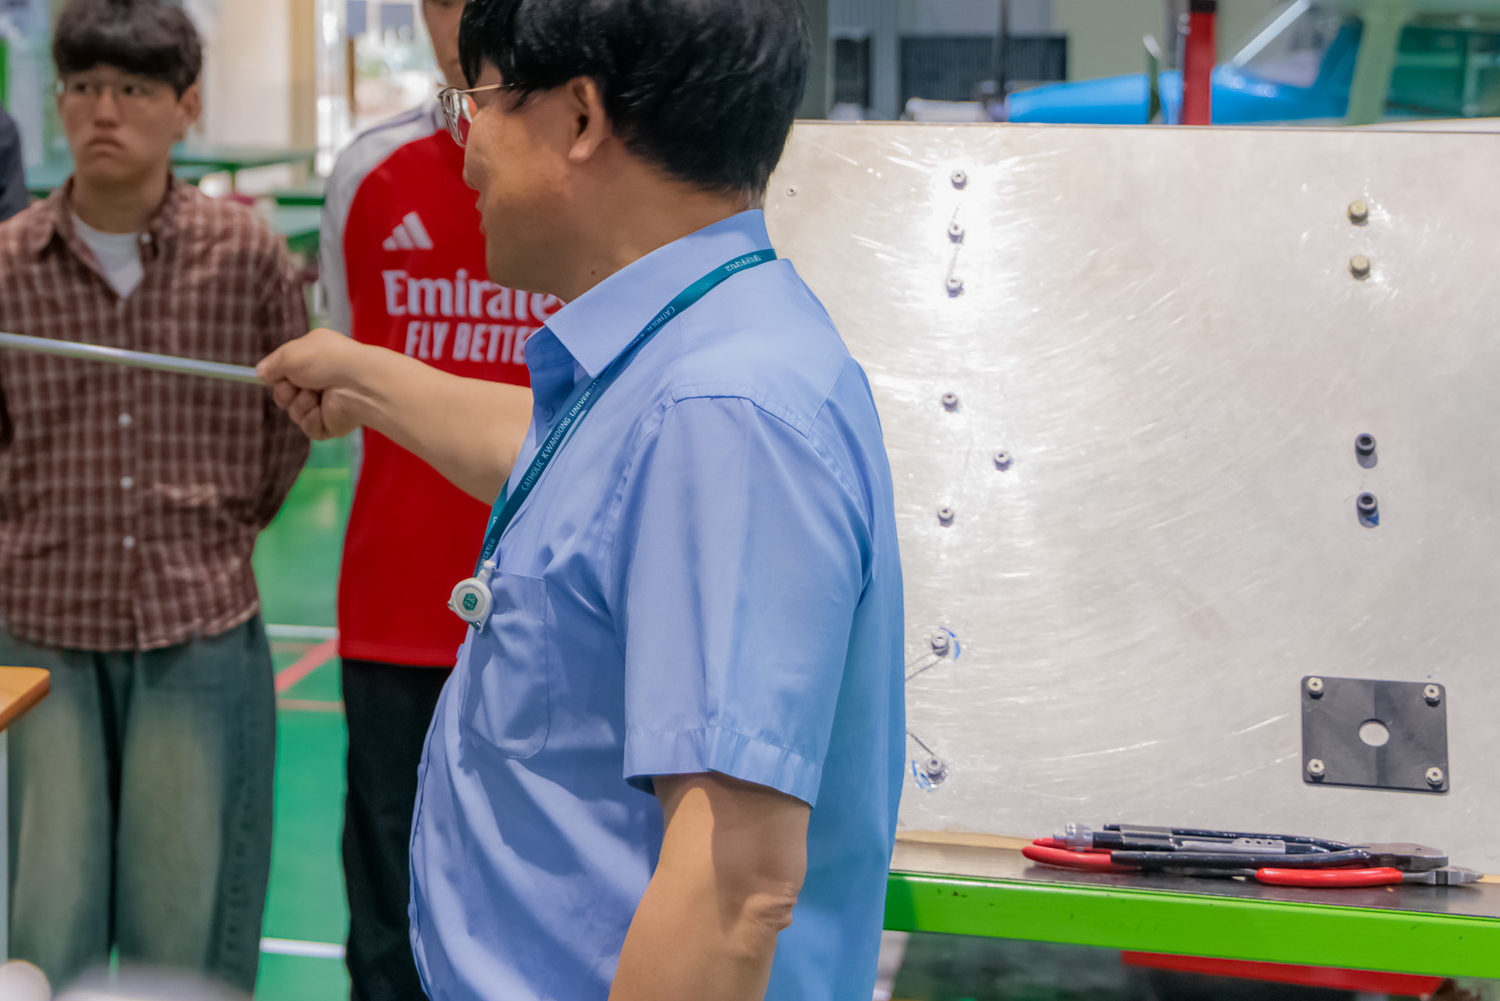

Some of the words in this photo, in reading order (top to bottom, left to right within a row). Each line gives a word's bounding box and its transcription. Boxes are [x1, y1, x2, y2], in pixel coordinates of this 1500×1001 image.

[381, 268, 565, 322] Emirate
[405, 320, 450, 360] FLY
[452, 321, 541, 365] BETTE
[521, 458, 545, 492] CATHOLIC
[540, 416, 571, 459] KWANDONG
